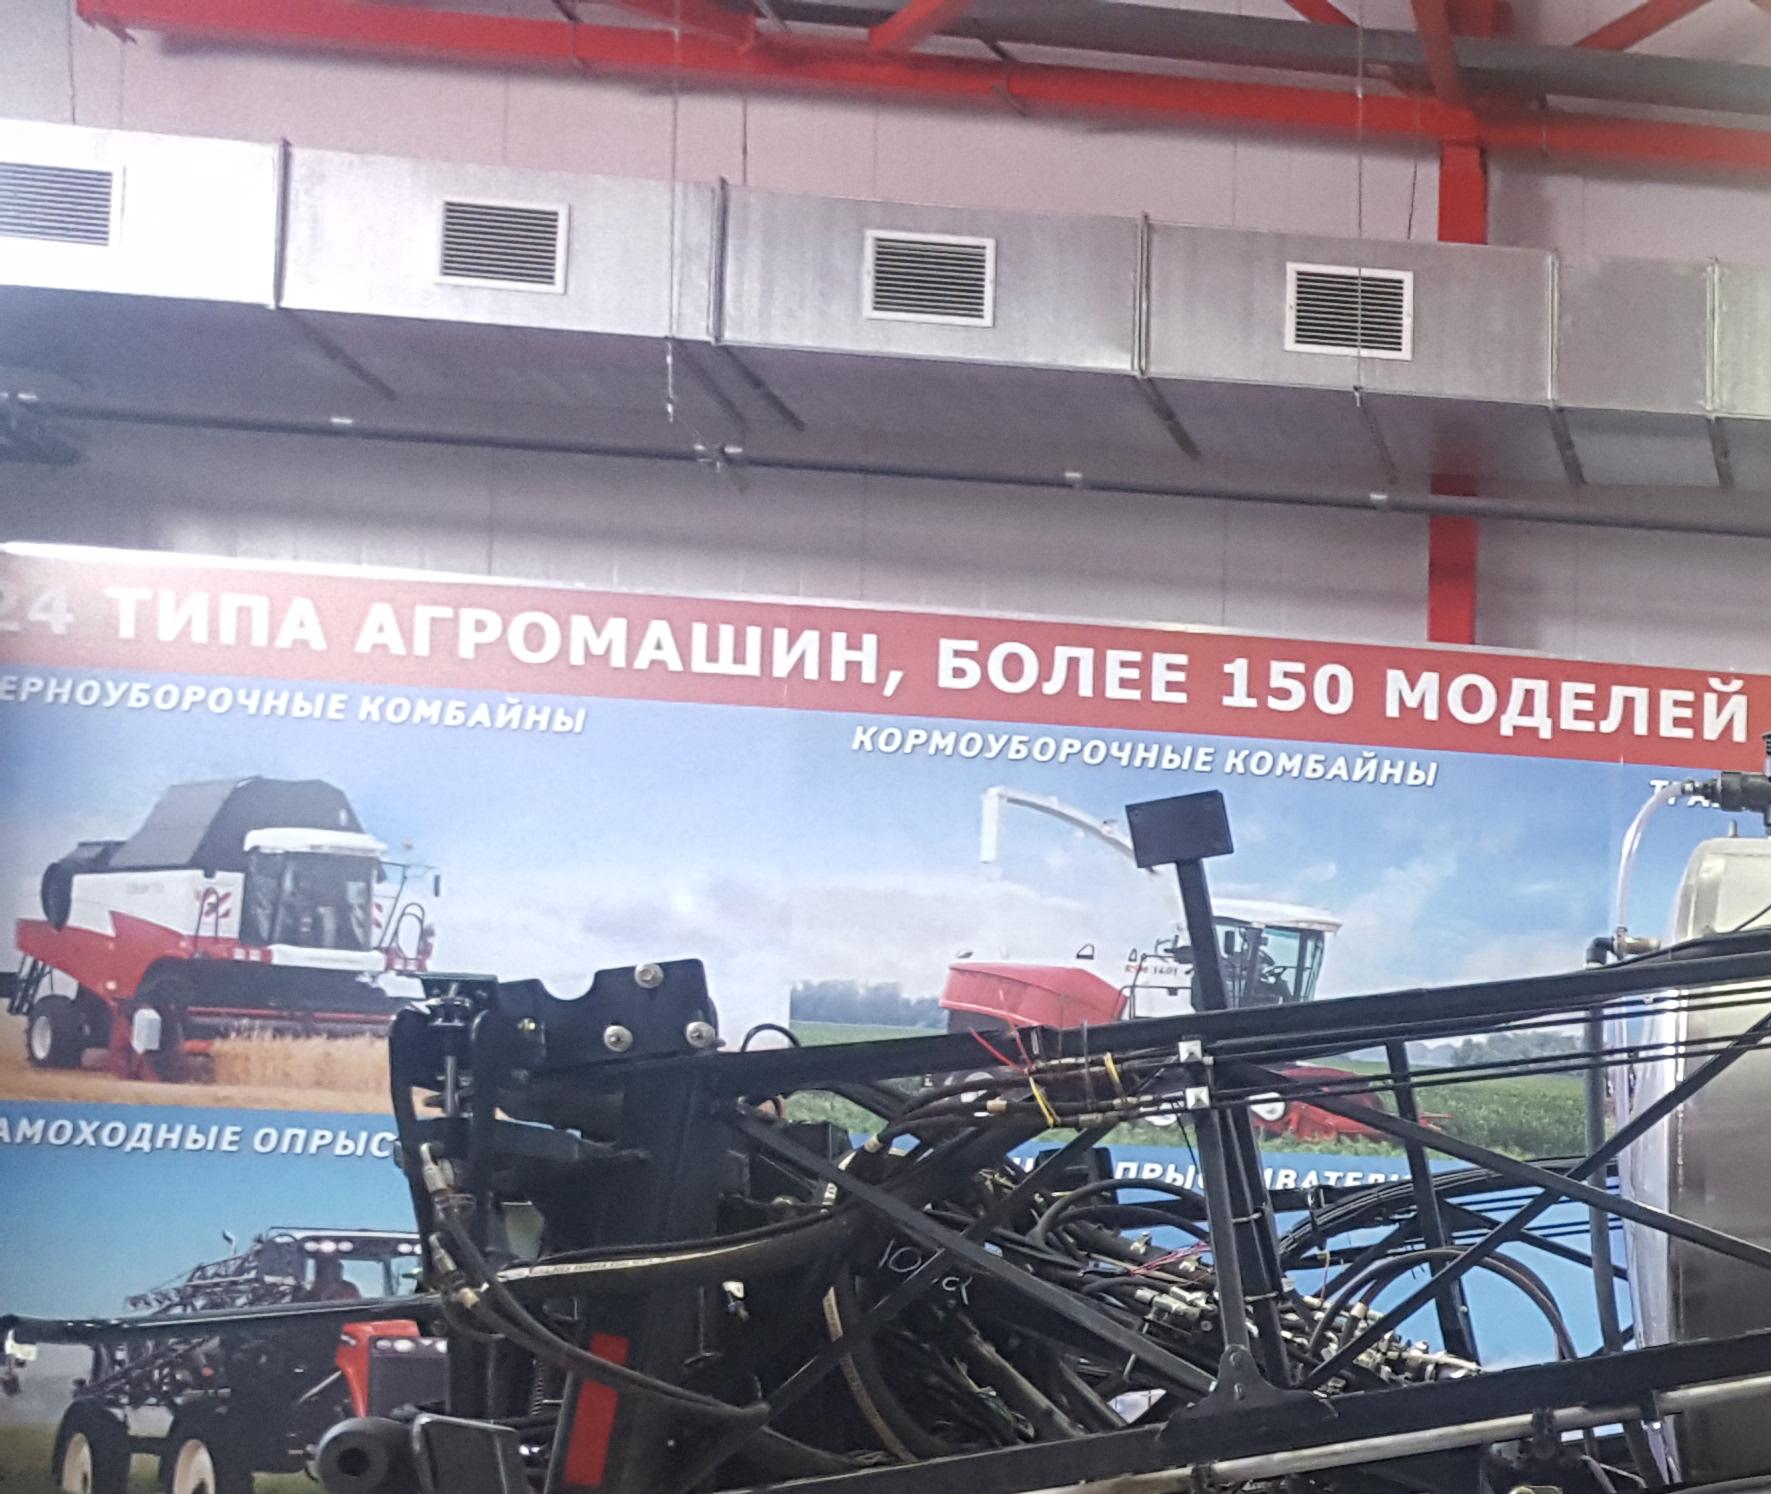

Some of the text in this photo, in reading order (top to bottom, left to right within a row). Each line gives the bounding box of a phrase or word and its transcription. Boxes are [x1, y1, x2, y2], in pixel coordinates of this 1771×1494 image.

[104, 587, 327, 652] ТИПА
[355, 601, 903, 697] АГРОМАШИН,
[938, 639, 1188, 704] БОЛЕЕ
[1222, 658, 1354, 715] 150
[1386, 668, 1750, 743] МОДЕЛЕЙ
[358, 695, 586, 734] КОМБАЙНЫ
[852, 725, 1438, 787] КОРМОУБОРОЧНЫЕ КОМБАЙНЫ
